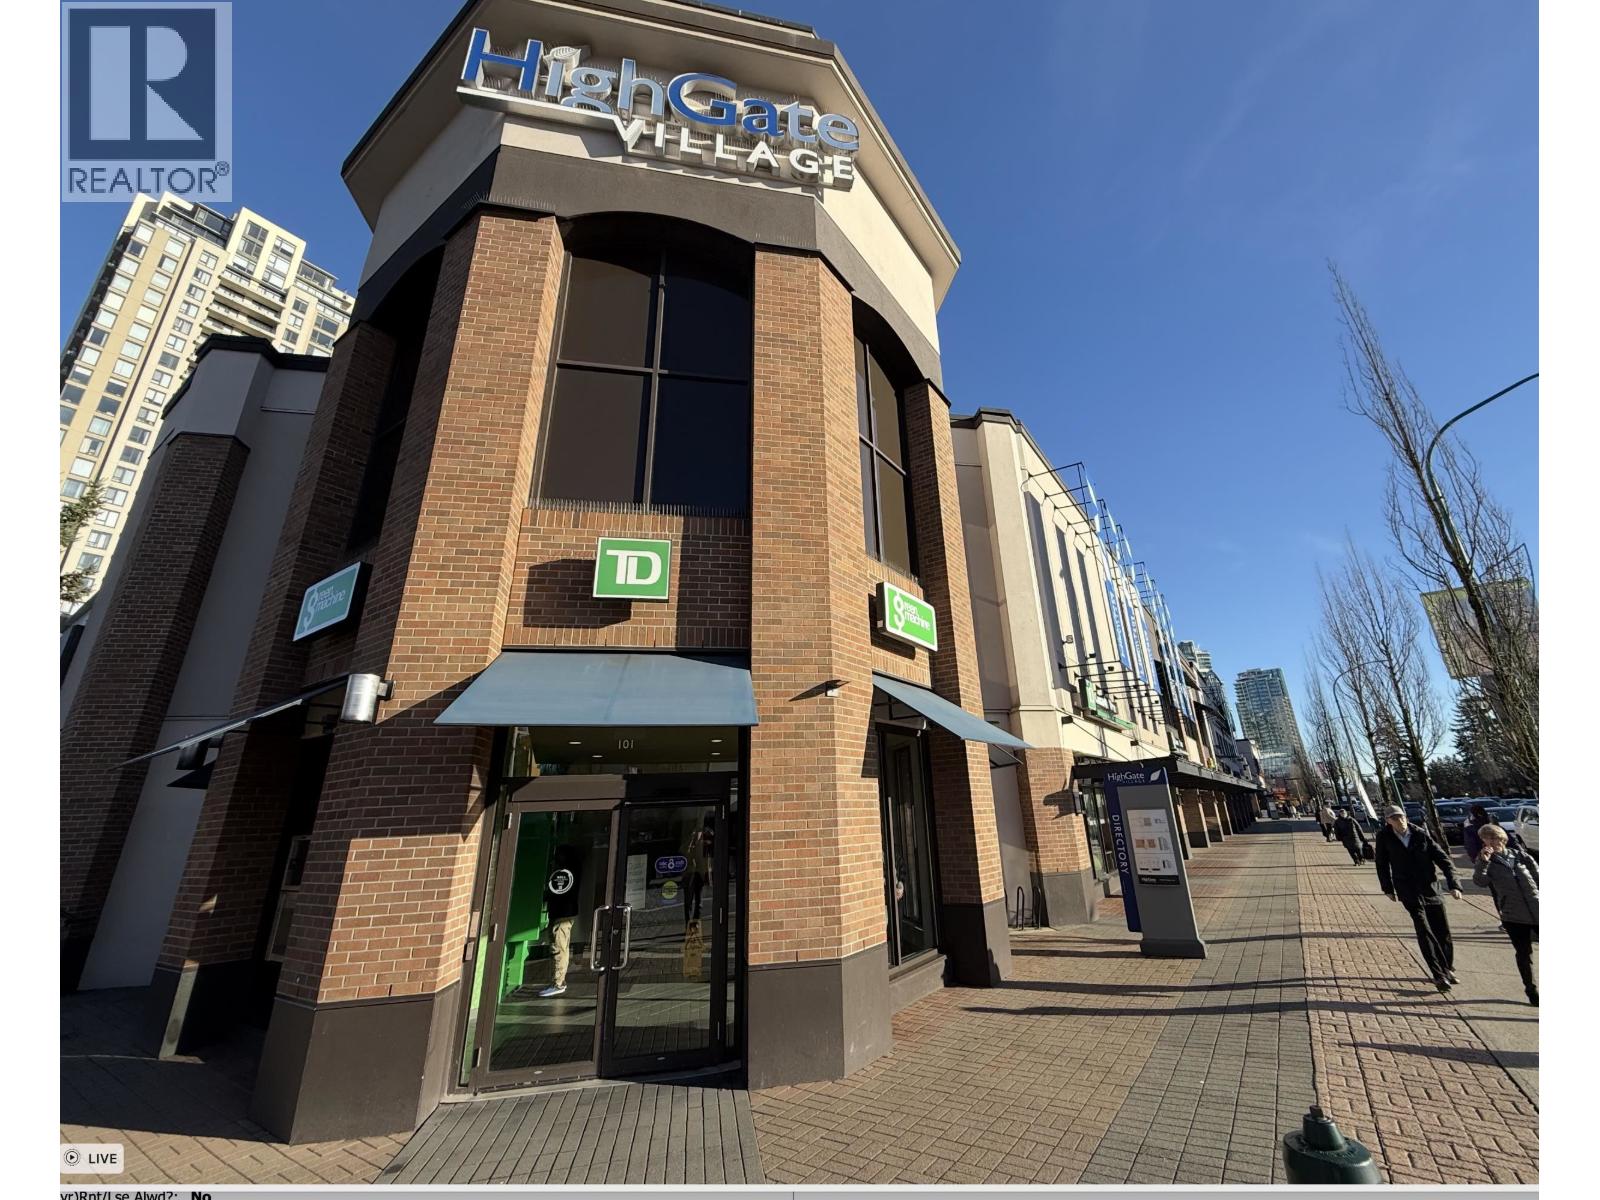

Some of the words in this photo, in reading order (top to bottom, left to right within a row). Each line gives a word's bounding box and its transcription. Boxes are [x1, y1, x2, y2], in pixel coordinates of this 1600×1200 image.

[460, 27, 860, 151] HighGate
[613, 115, 854, 184] VILLAGE
[606, 549, 662, 586] TD
[618, 739, 634, 749] 101
[1107, 771, 1145, 782] HighGate
[1112, 815, 1129, 874] DIRECTORY
